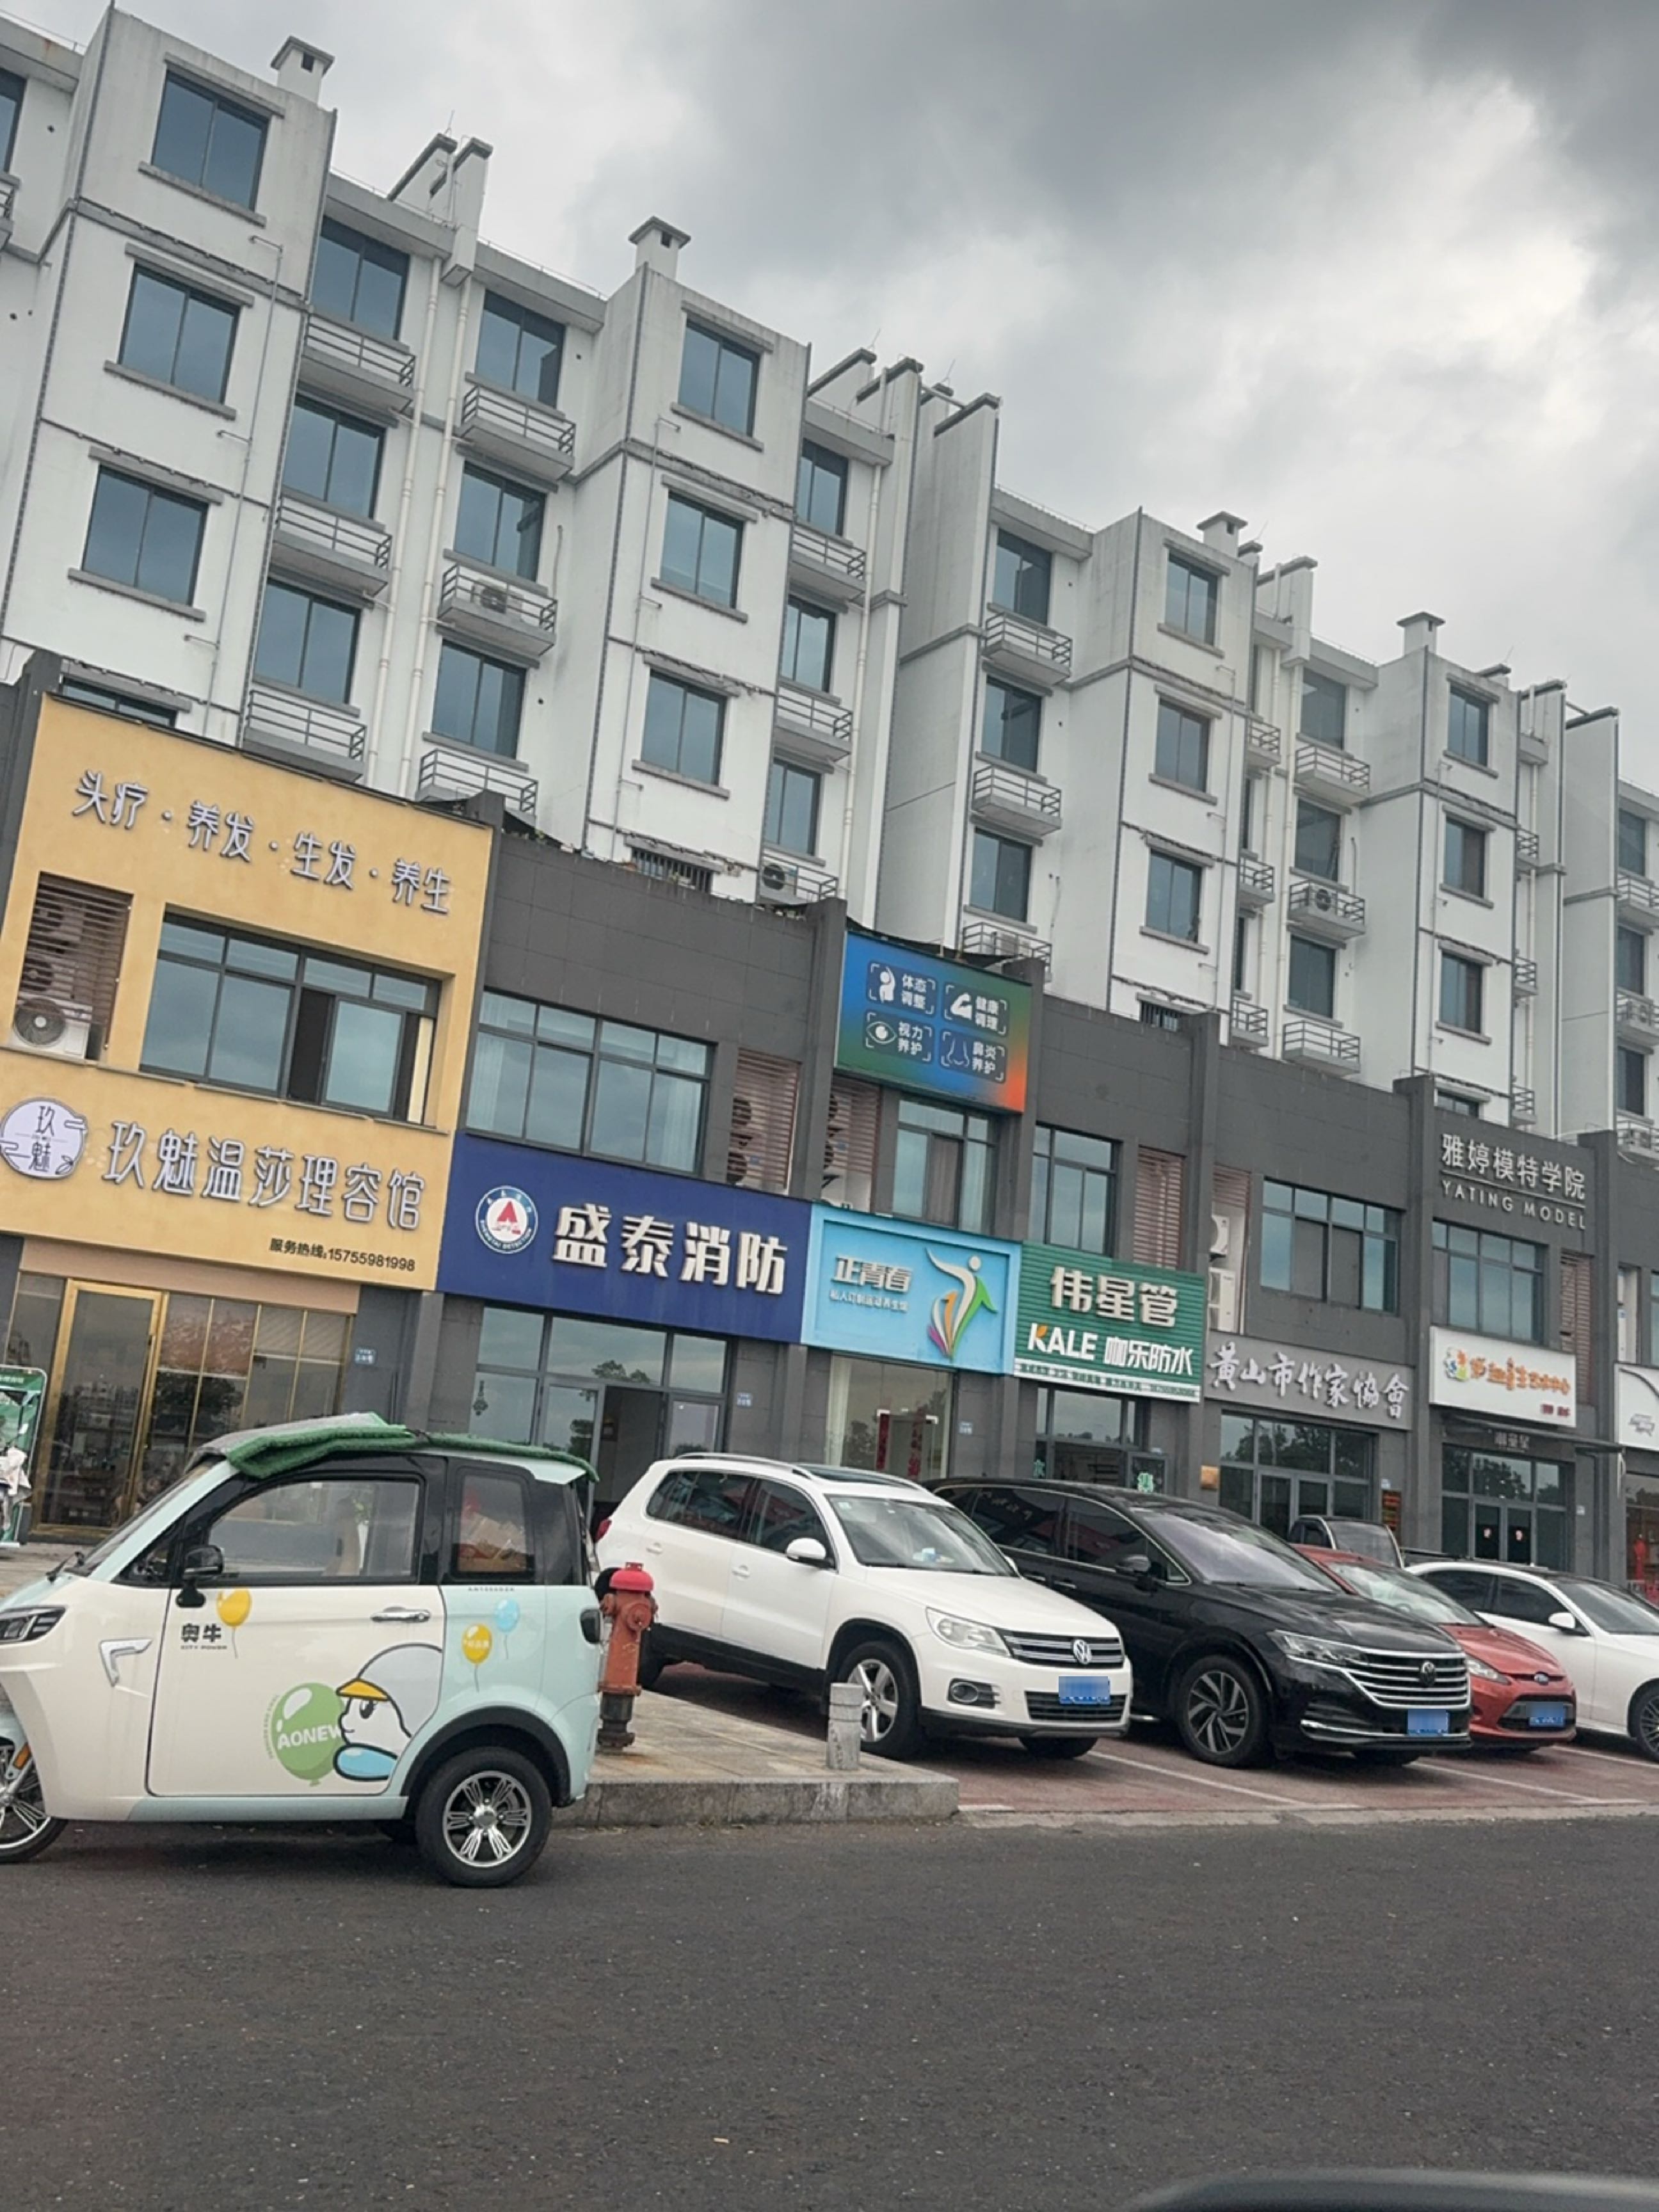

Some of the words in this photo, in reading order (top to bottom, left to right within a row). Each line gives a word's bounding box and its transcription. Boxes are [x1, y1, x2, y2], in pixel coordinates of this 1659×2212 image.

[898, 1021, 923, 1041] 视力
[102, 1119, 426, 1231] 玖魅温莎理容馆
[1441, 1132, 1586, 1201] 雅婷模特学院
[1442, 1180, 1514, 1212] YATING
[1523, 1201, 1587, 1230] MODEL
[551, 1203, 788, 1295] 盛泰消防
[1050, 1265, 1179, 1328] 伟星管
[1027, 1322, 1098, 1362] KALE
[1104, 1335, 1194, 1376] 咖乐防水
[180, 1623, 222, 1643] 奥牛
